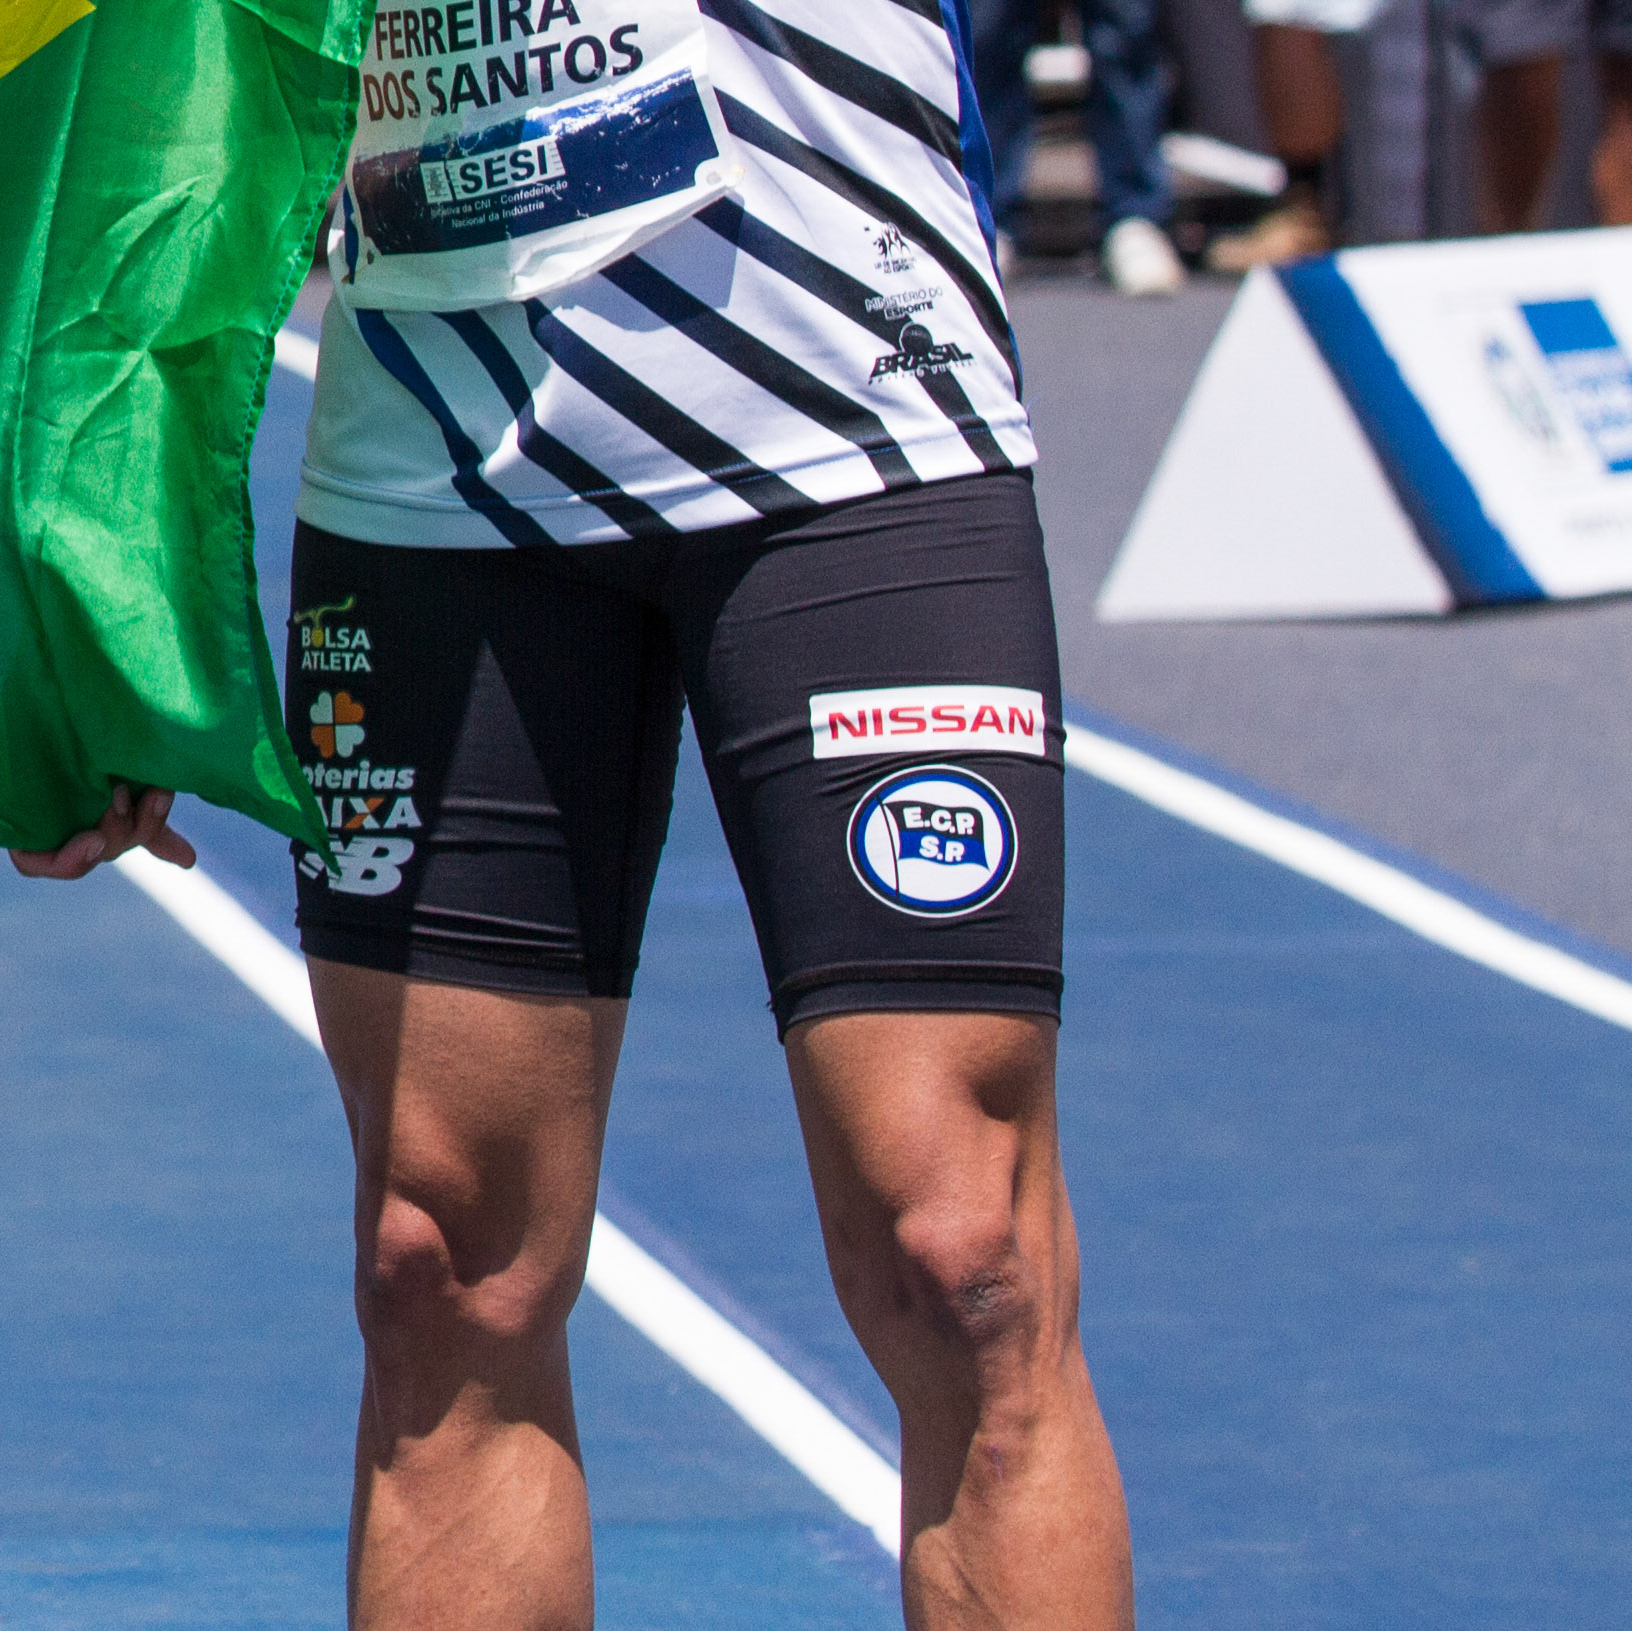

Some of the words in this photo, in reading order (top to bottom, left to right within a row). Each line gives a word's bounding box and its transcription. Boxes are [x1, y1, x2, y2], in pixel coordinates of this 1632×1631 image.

[363, 69, 421, 122] DOS
[425, 23, 644, 117] SANTOS
[458, 144, 549, 194] SESI
[474, 198, 492, 211] CNI
[488, 211, 500, 223] da
[502, 200, 545, 219] Indústria
[883, 300, 934, 321] ESPORTE
[869, 342, 974, 378] BRASIL
[301, 650, 372, 673] ATLETA
[827, 704, 1035, 741] NISSAN
[901, 805, 976, 836] E.C.P.
[918, 834, 966, 863] S.P.
